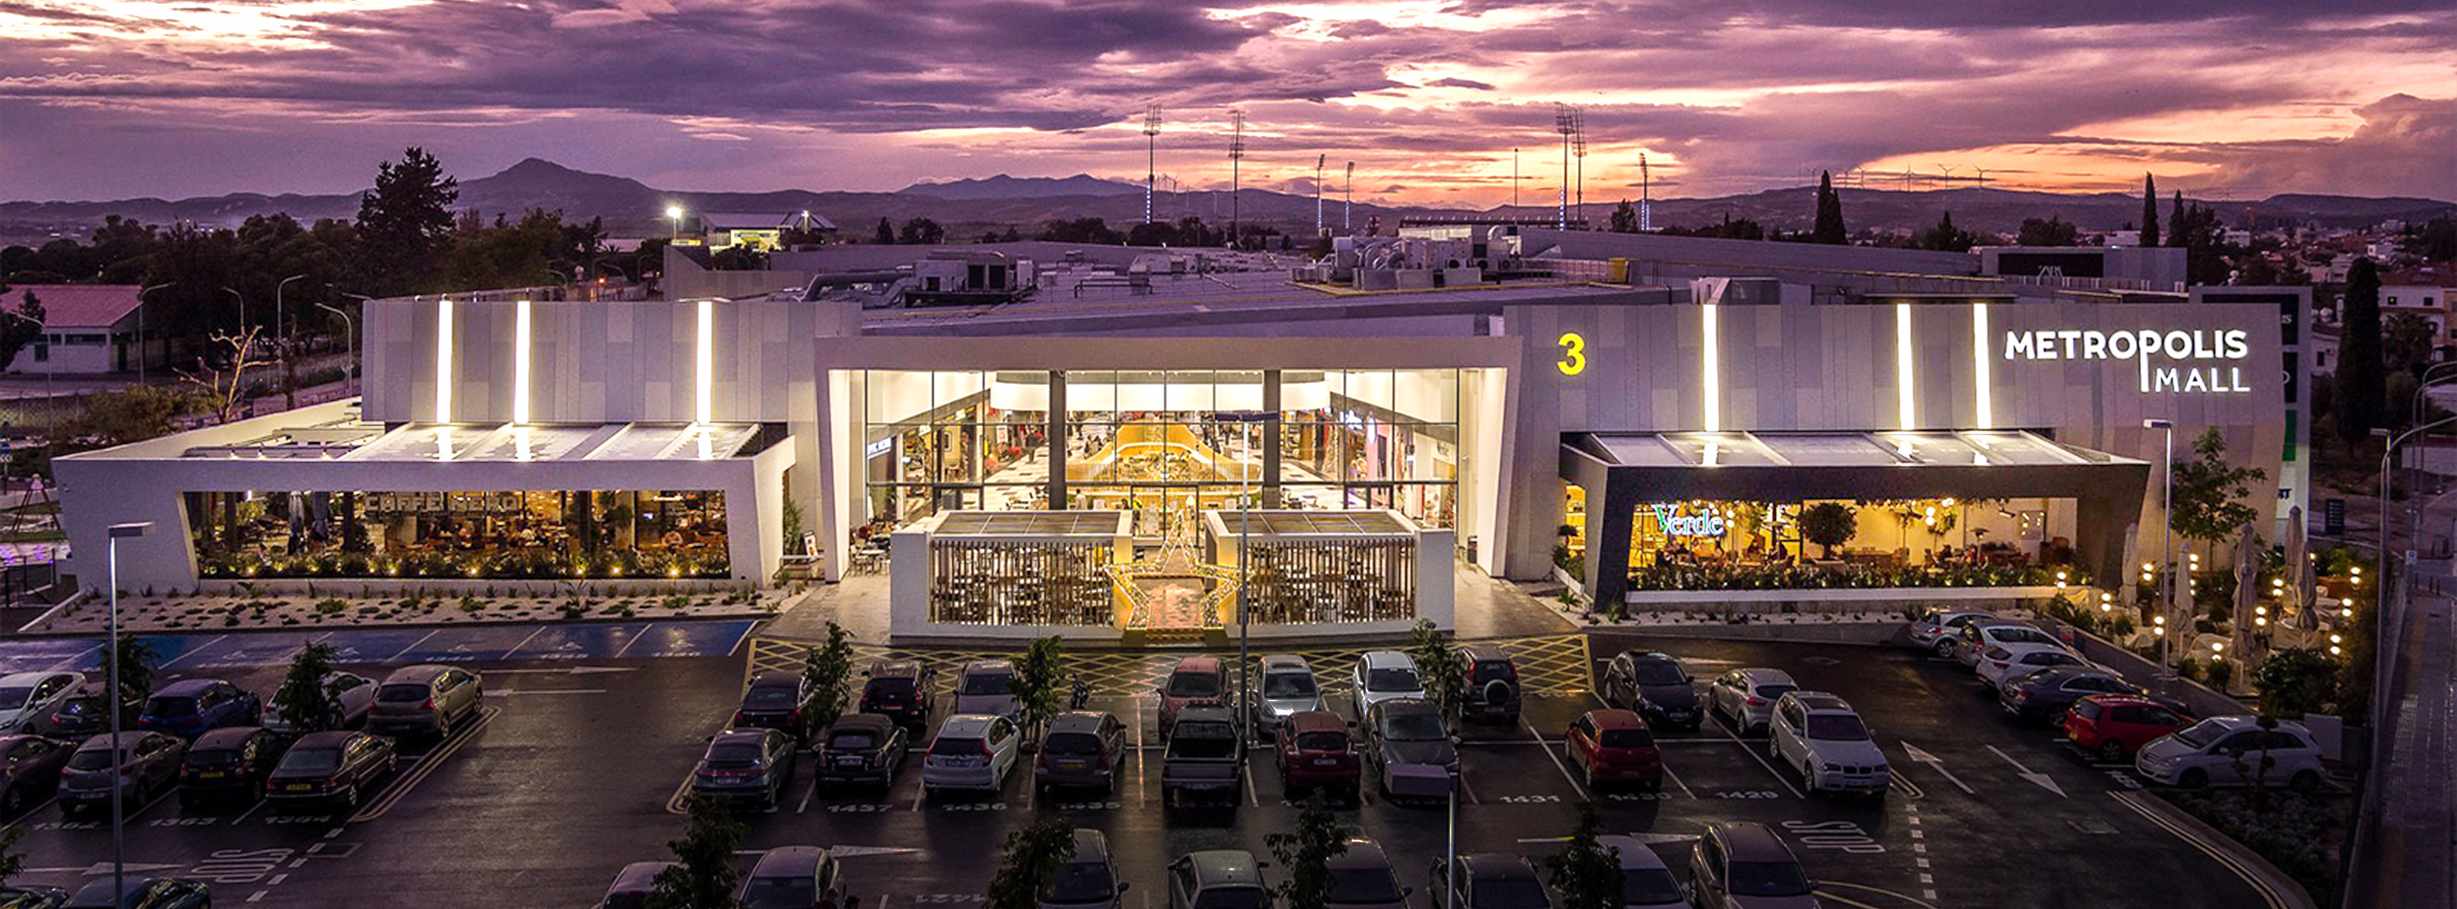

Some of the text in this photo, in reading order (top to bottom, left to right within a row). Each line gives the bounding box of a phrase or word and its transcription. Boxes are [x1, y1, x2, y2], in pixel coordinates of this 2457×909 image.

[1557, 332, 1586, 376] 3
[2004, 329, 2248, 392] METROPOLIS
[2154, 367, 2250, 392] MALL
[1651, 504, 1725, 535] Verde
[1499, 795, 1560, 803] 1431
[1780, 820, 1886, 854] STOP
[182, 848, 295, 884] STOP
